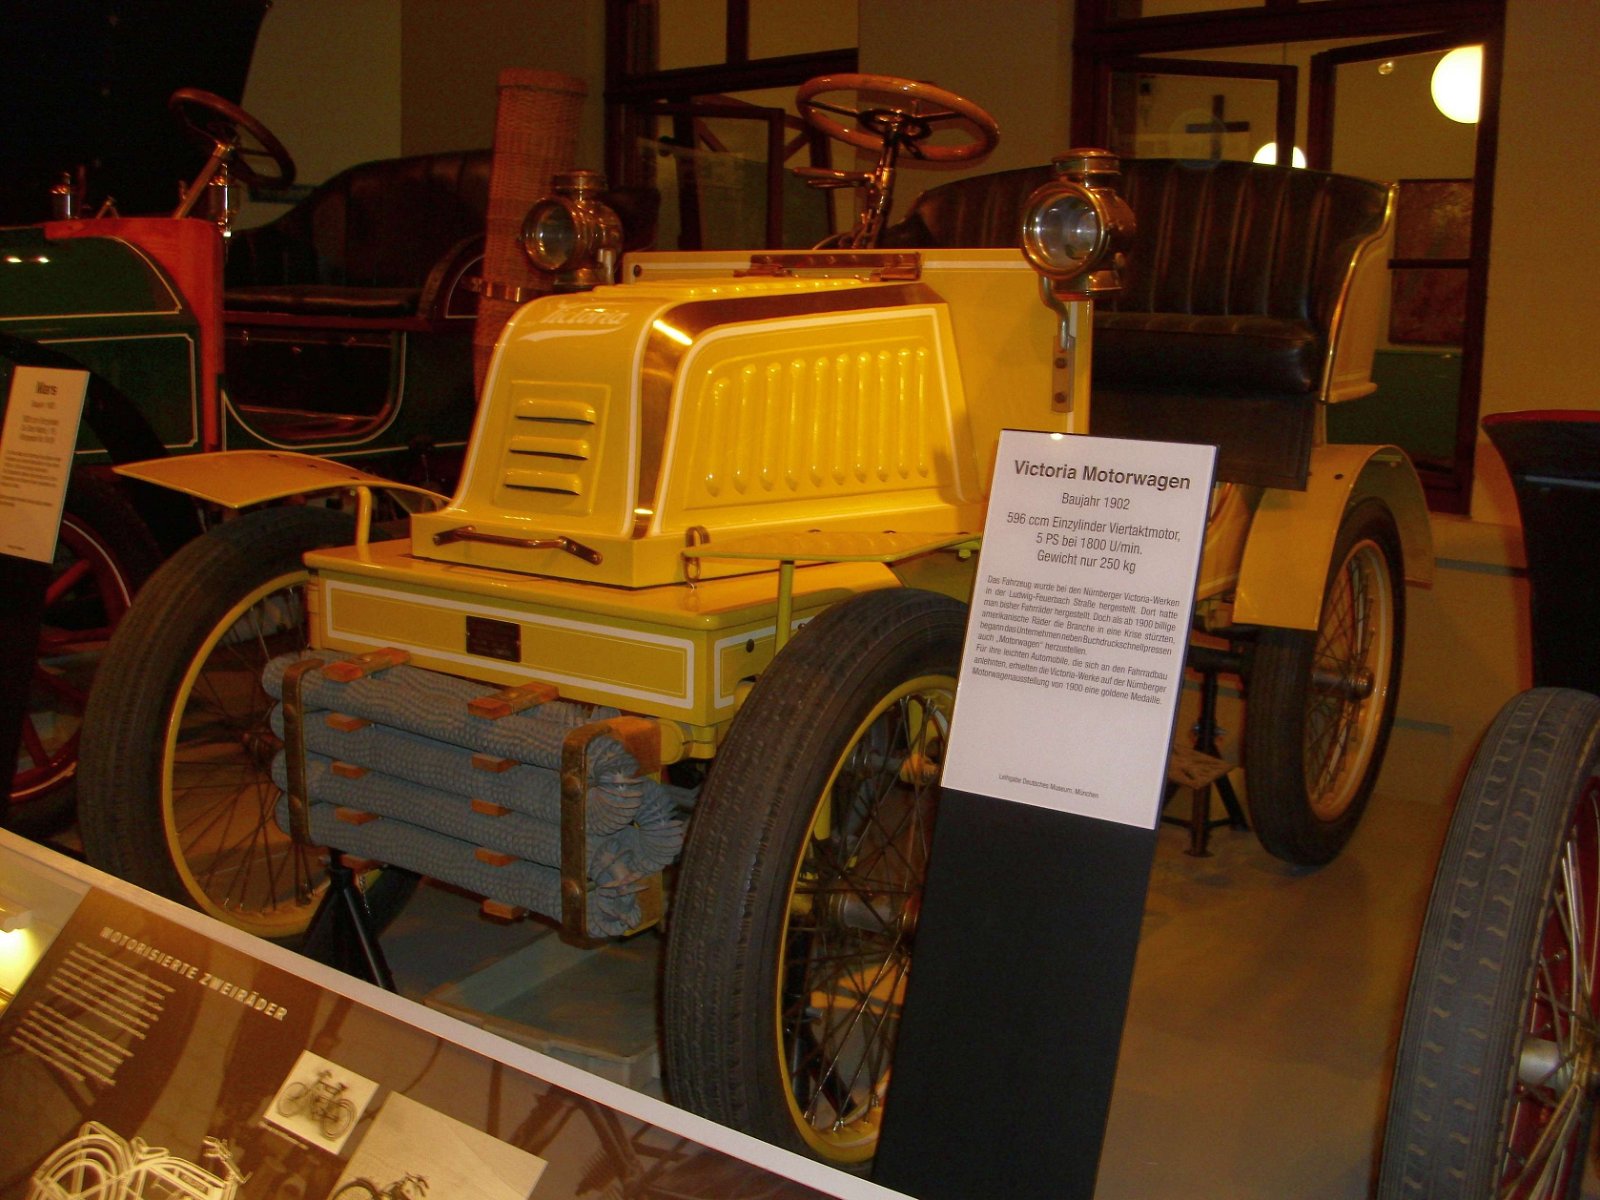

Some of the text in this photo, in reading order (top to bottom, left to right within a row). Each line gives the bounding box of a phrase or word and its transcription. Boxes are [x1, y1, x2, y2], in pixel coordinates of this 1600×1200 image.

[1014, 460, 1190, 491] Victoria Motorwagen
[1062, 493, 1130, 510] Baujahr 1902
[1007, 512, 1181, 542] 596 ccm Einzylinder Viertaktmotor,
[1036, 532, 1142, 555] 5 PS bei 1800 U/min.
[1037, 550, 1136, 574] Gewicht nur 250 kg
[986, 586, 992, 595] in
[994, 588, 1006, 597] der
[1009, 590, 1070, 605] Ludwig-Feuerbach
[1073, 598, 1096, 609] Straße
[1140, 606, 1156, 617] Dort
[1159, 610, 1178, 620] hatte
[987, 574, 1180, 607] Das Fahrzeug wurde bei den Nürnberger Victoria-Werken
[982, 610, 1030, 623] amerikanische
[1032, 615, 1052, 626] Räder
[1054, 618, 1064, 628] die
[1066, 620, 1094, 632] Branche
[1097, 626, 1104, 634] in
[1106, 626, 1122, 636] eine
[1124, 629, 1142, 638] Krise
[984, 599, 998, 607] man
[1000, 600, 1020, 610] bisher
[1021, 602, 1054, 614] Fahrräder
[1093, 612, 1110, 622] Doch
[1112, 616, 1122, 624] als
[1124, 617, 1133, 626] ab
[1136, 618, 1154, 628] 1900
[1154, 620, 1176, 632] billige
[978, 632, 994, 642] auch
[980, 620, 1172, 656] begann das Unternehmen neben Buchdruckschnellpressen
[974, 656, 1168, 694] anlehnten, erhielten die Victoria-Werke auf der Nürnberger
[976, 644, 987, 653] Für
[988, 646, 1001, 655] ihre
[1004, 648, 1029, 659] leichten
[1030, 652, 1070, 666] Automobile,
[1072, 659, 1082, 668] die
[1084, 660, 1100, 670] sich
[1112, 664, 1125, 674] den
[1128, 666, 1168, 680] Fahrradbau
[972, 667, 1162, 704] Motorwagenausstellung von 1900 eine goldene Medaille.
[1022, 778, 1049, 789] Deutsches
[100, 926, 199, 980] MOTORISIERTE
[198, 972, 288, 1022] ZWEIRÄDER
